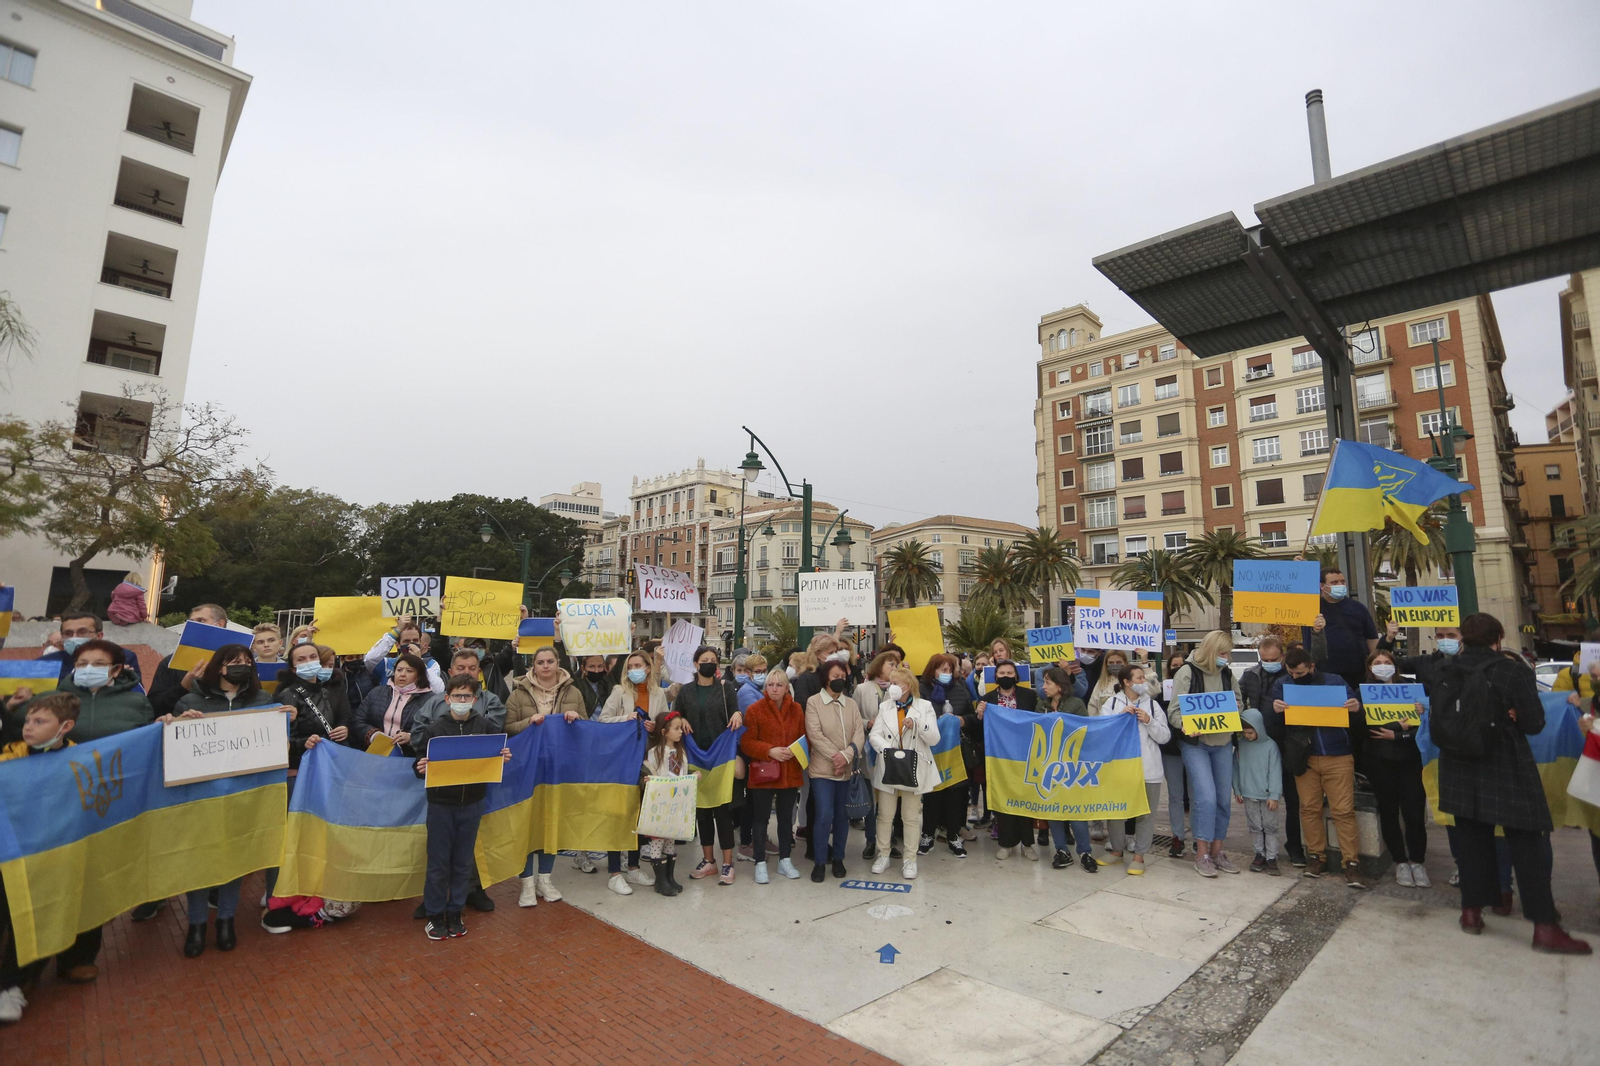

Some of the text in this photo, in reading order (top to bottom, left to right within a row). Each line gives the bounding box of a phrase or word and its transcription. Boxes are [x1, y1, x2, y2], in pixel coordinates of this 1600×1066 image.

[639, 564, 679, 580] STOP
[1238, 569, 1299, 581] NO WAR IN
[385, 577, 439, 599] STOP
[644, 578, 687, 602] Russia
[801, 578, 830, 592] PUTIN
[837, 578, 871, 591] HITLER
[1258, 583, 1292, 592] UKRAINE
[444, 590, 496, 610] #STOP
[1393, 588, 1453, 604] NO WAR
[385, 597, 434, 616] WAR
[1079, 608, 1106, 619] STOP
[1243, 605, 1268, 618] STOP
[1274, 607, 1301, 619] PUTIN
[1393, 609, 1456, 623] IN EUROPE
[587, 618, 599, 630] A
[1079, 620, 1111, 630] FROM
[1030, 628, 1061, 643] STOP
[1035, 645, 1068, 660] WAR
[1367, 685, 1412, 700] SAVE
[1185, 693, 1227, 712] STOP
[1192, 714, 1229, 730] WAR
[175, 722, 217, 739] PUTIN
[1006, 798, 1127, 813] НАРОДНИЙ РУХ УКРАЇНИ
[846, 881, 905, 891] SALIDA
